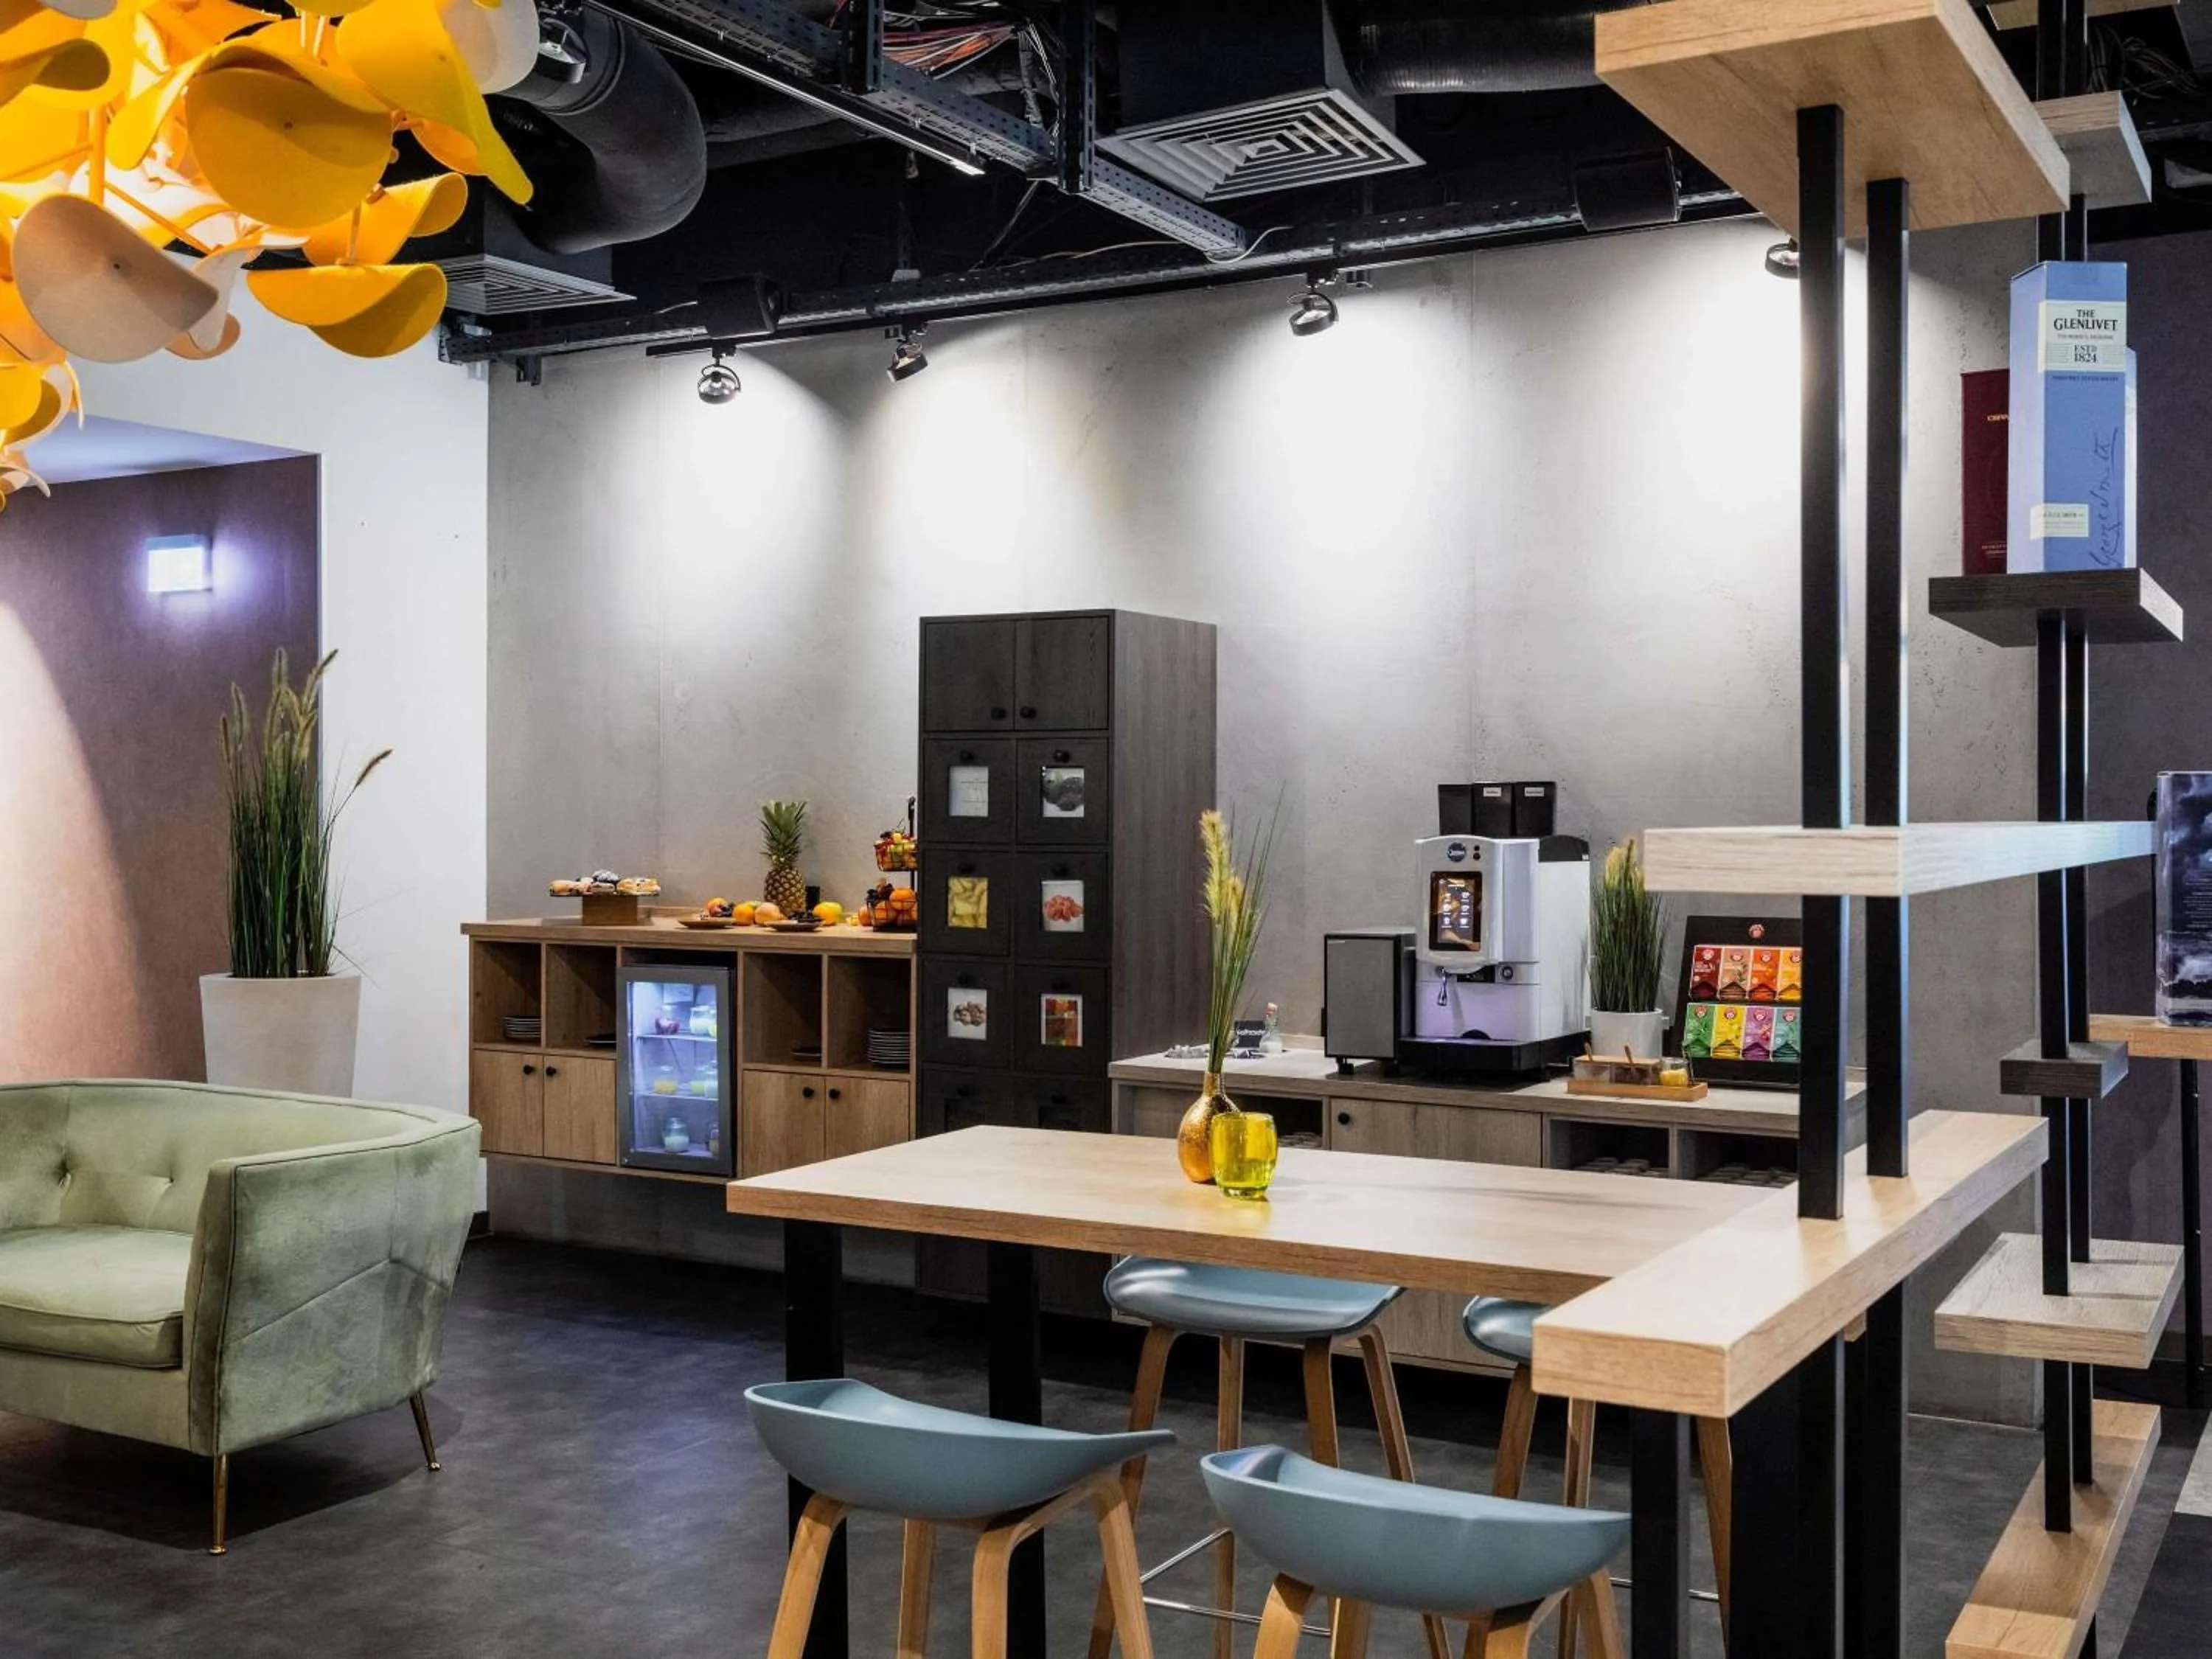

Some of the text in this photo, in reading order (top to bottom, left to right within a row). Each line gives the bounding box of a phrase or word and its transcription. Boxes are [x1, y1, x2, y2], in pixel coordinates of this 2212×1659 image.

[2076, 309, 2096, 318] THE
[2053, 318, 2118, 331] GLENLIVET
[2074, 353, 2097, 363] 1824
